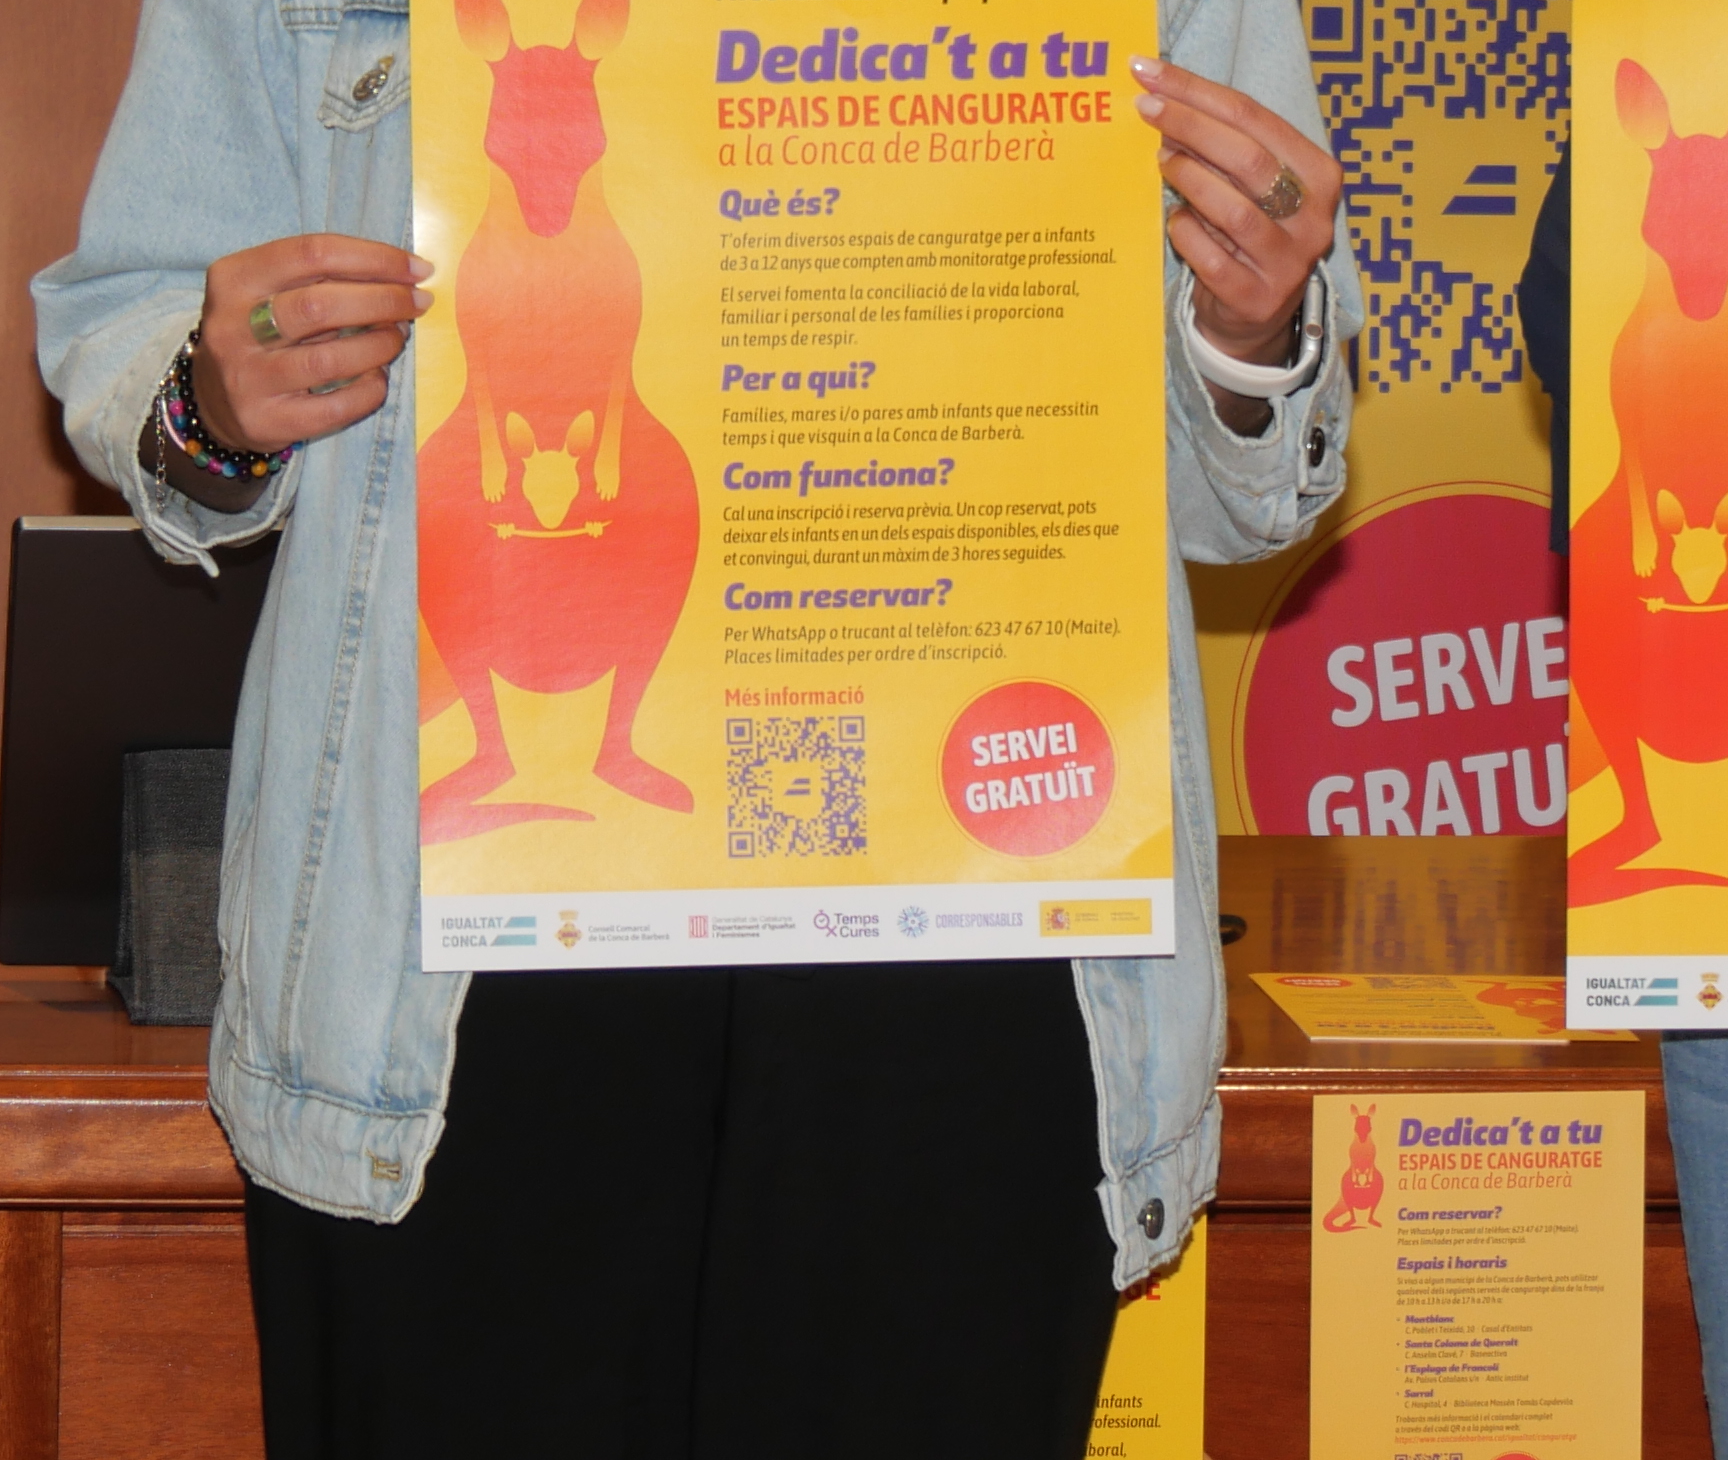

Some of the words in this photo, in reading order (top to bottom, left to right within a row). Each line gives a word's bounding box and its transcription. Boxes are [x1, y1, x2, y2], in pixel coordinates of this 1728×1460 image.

[716, 26, 976, 83] Dedica't
[989, 42, 1027, 79] a
[1041, 32, 1109, 78] tu
[718, 96, 829, 129] ESPAIS
[838, 95, 880, 127] DE
[889, 91, 1111, 126] CANGURATGE
[719, 144, 736, 166] a
[746, 134, 773, 166] la
[782, 135, 875, 165] Conca
[884, 131, 920, 163] de
[929, 129, 1055, 162] Barberà
[719, 189, 780, 221] Què
[787, 187, 840, 216] és?
[721, 233, 781, 248] T'oferim
[785, 232, 845, 247] diversos
[849, 232, 894, 249] espais
[897, 230, 915, 245] de
[918, 231, 1002, 248] canguratge
[1005, 232, 1030, 247] per
[1033, 232, 1041, 243] a
[1045, 227, 1095, 243] infants
[722, 364, 776, 391] Per
[781, 372, 801, 391] a
[807, 361, 876, 398] qui?
[723, 462, 791, 490] Com
[799, 458, 955, 496] funciona?
[724, 583, 793, 610] Com
[799, 578, 953, 609] reservar?
[725, 627, 749, 641] Per
[752, 626, 826, 644] WhatsApp
[830, 628, 838, 639] o
[842, 625, 895, 639] trucant
[899, 623, 912, 638] al
[916, 622, 972, 638] telèfon:
[975, 621, 1001, 636] 623
[1004, 621, 1022, 635] 47
[1025, 620, 1043, 635] 67
[1046, 620, 1063, 635] 10
[1065, 618, 1120, 638] (Maite).
[1326, 616, 1569, 728] SERVE
[725, 688, 761, 706] Més
[765, 686, 864, 706] informació
[972, 723, 1077, 766] SERVEI
[966, 764, 1095, 813] GRATUÏT
[1307, 743, 1568, 836] GRATU
[442, 917, 503, 929] IGUALTAT
[832, 913, 879, 932] Temps
[838, 923, 879, 938] Cures
[936, 912, 1023, 928] CORRESPONSABLES
[442, 935, 487, 947] CONCA
[1399, 1117, 1534, 1147] Dedica't
[1540, 1125, 1560, 1145] a
[1567, 1120, 1602, 1144] tu
[1397, 1257, 1444, 1273] Espais
[1447, 1256, 1452, 1269] i
[1455, 1256, 1507, 1269] horaris
[1096, 1394, 1143, 1409] infants
[1094, 1413, 1161, 1428] ofessional.
